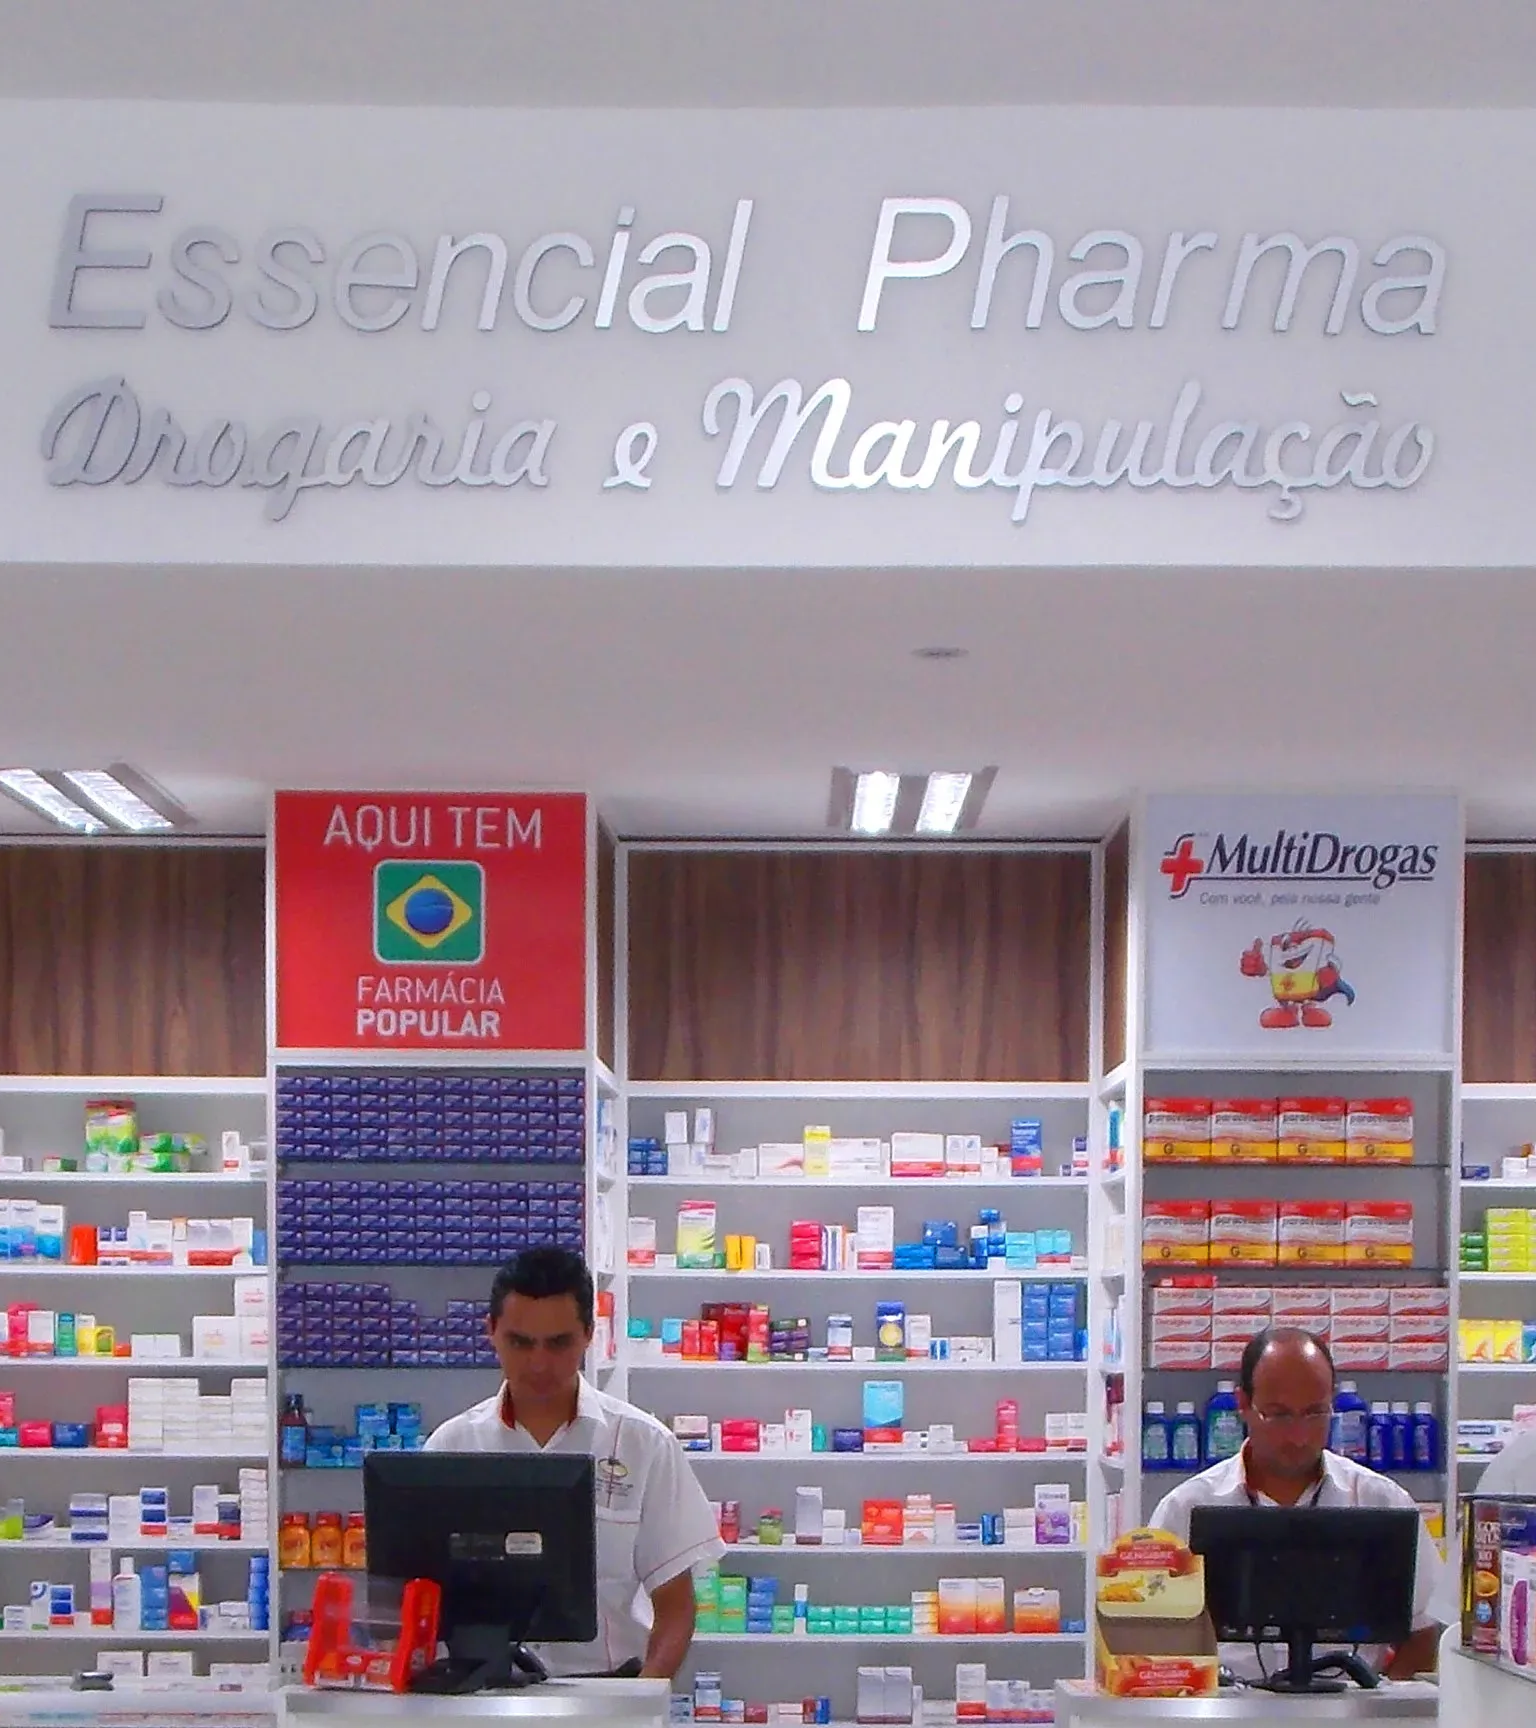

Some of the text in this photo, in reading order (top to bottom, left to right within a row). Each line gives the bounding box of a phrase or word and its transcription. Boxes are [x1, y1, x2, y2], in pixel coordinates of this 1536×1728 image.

[47, 194, 1451, 336] Essencial Pharma
[41, 375, 1436, 522] Drogaria e Manipulação
[323, 804, 542, 852] AQUI TEM
[1205, 829, 1439, 890] MultiDrogas
[357, 970, 506, 1004] FARMÁCIA
[356, 1008, 501, 1038] POPULAR
